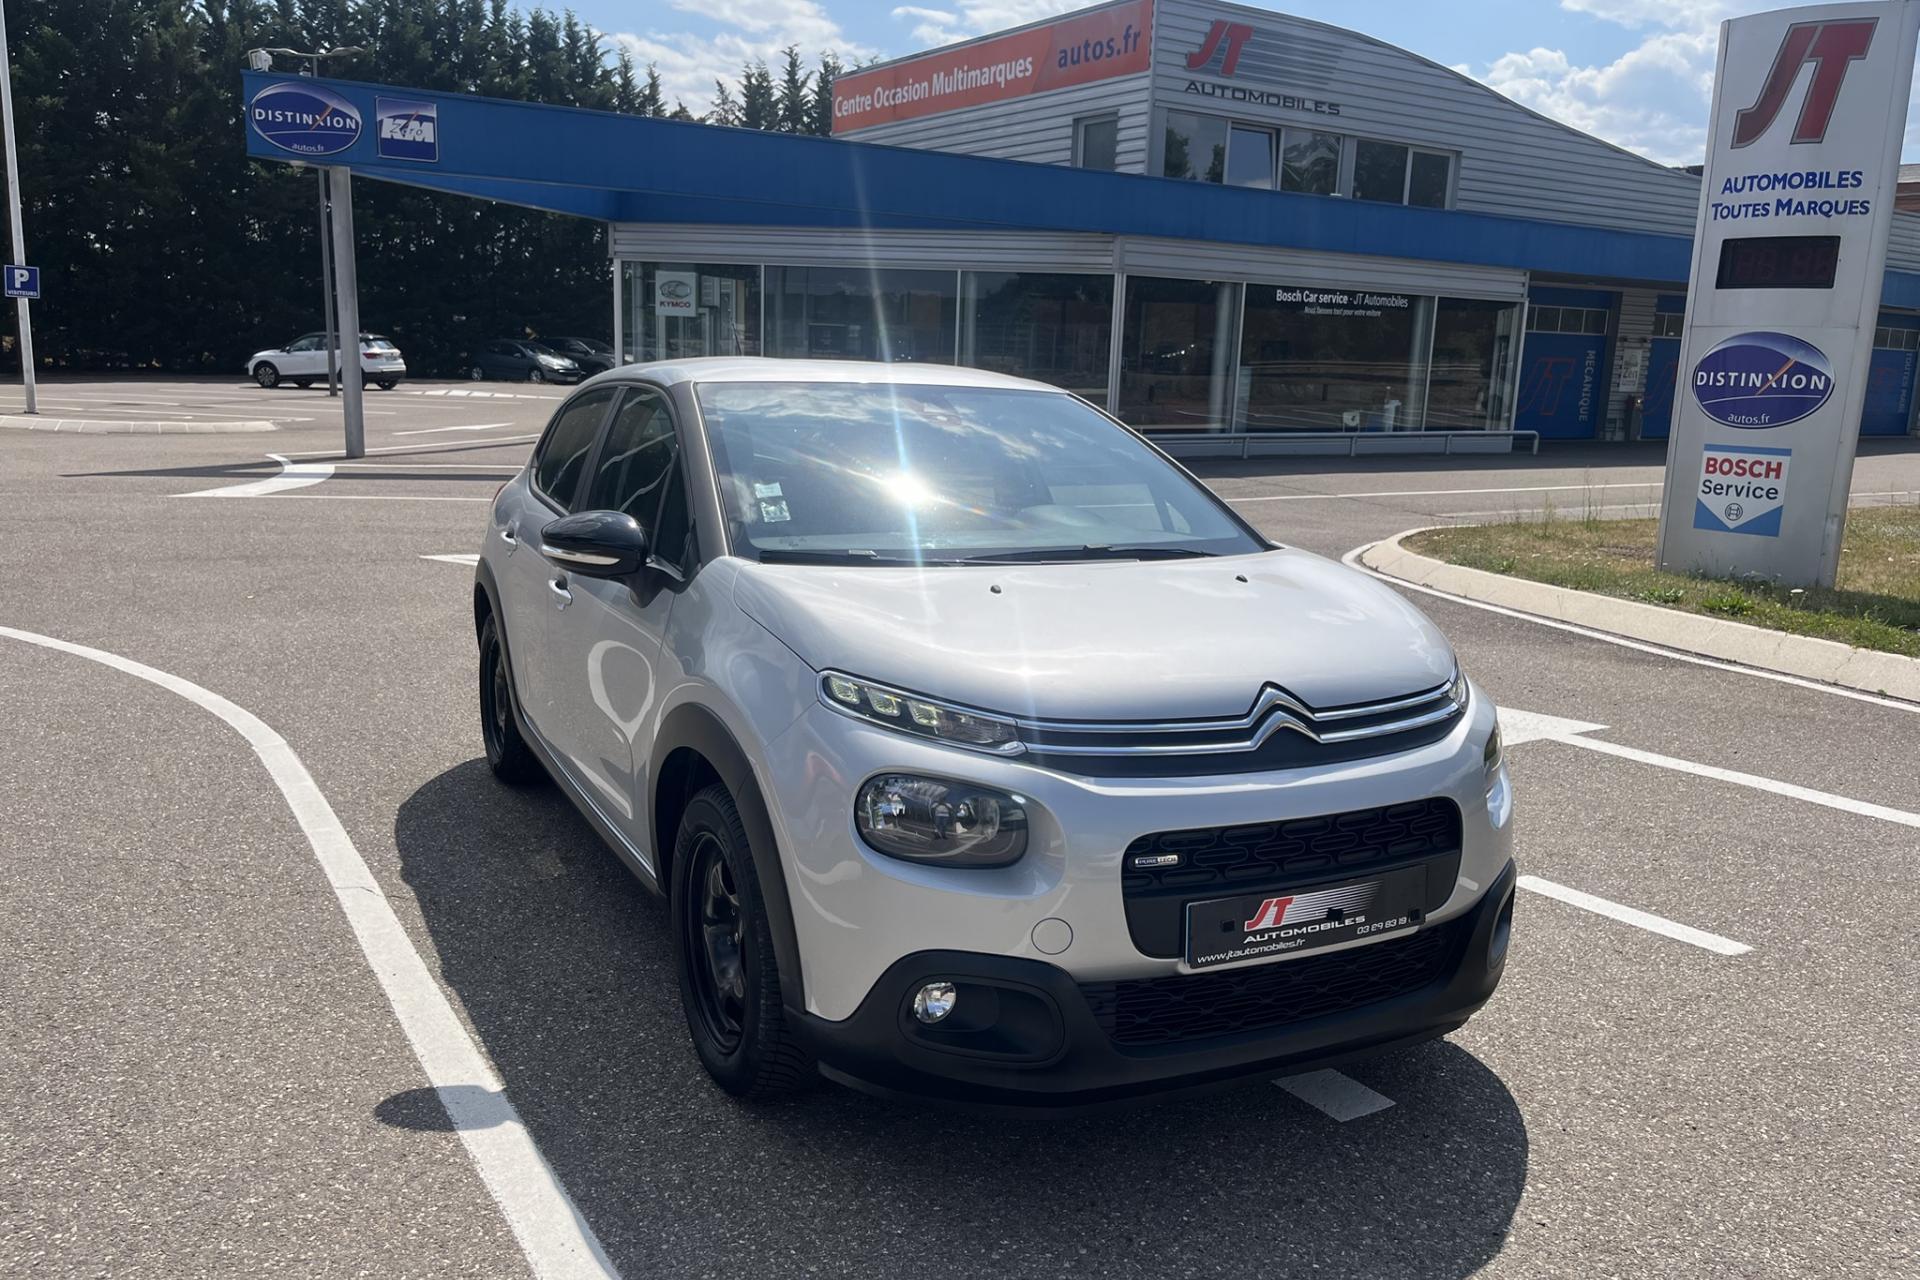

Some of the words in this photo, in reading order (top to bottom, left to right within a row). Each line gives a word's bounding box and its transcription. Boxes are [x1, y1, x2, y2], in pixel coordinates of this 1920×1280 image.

[1058, 25, 1141, 68] autos.fr
[1186, 19, 1254, 77] JT
[835, 94, 871, 117] Centre
[874, 79, 928, 109] Occasion
[932, 55, 1033, 97] Multimarques
[1730, 17, 1879, 149] JT
[1185, 81, 1341, 116] AUTOMOBILES
[255, 107, 356, 131] DISTINXION
[291, 143, 324, 152] autos.fr
[1721, 171, 1863, 195] AUTOMOBILES
[15, 269, 29, 288] P
[1276, 289, 1301, 302] Bosch
[1303, 291, 1318, 303] Car
[1319, 292, 1348, 304] service
[1353, 293, 1363, 305] JT
[1364, 294, 1408, 307] Automobiles
[1579, 350, 1596, 421] MECANIQUE
[1697, 367, 1826, 392] DISTINXION
[1728, 414, 1771, 424] autos.fr
[1705, 457, 1782, 480] BOSCH
[1701, 479, 1779, 500] Service
[1244, 896, 1295, 932] JT
[1243, 915, 1366, 944] AUTOMOBILES
[1357, 925, 1369, 934] 03
[1197, 937, 1306, 964] www.jtautomobiles.fr
